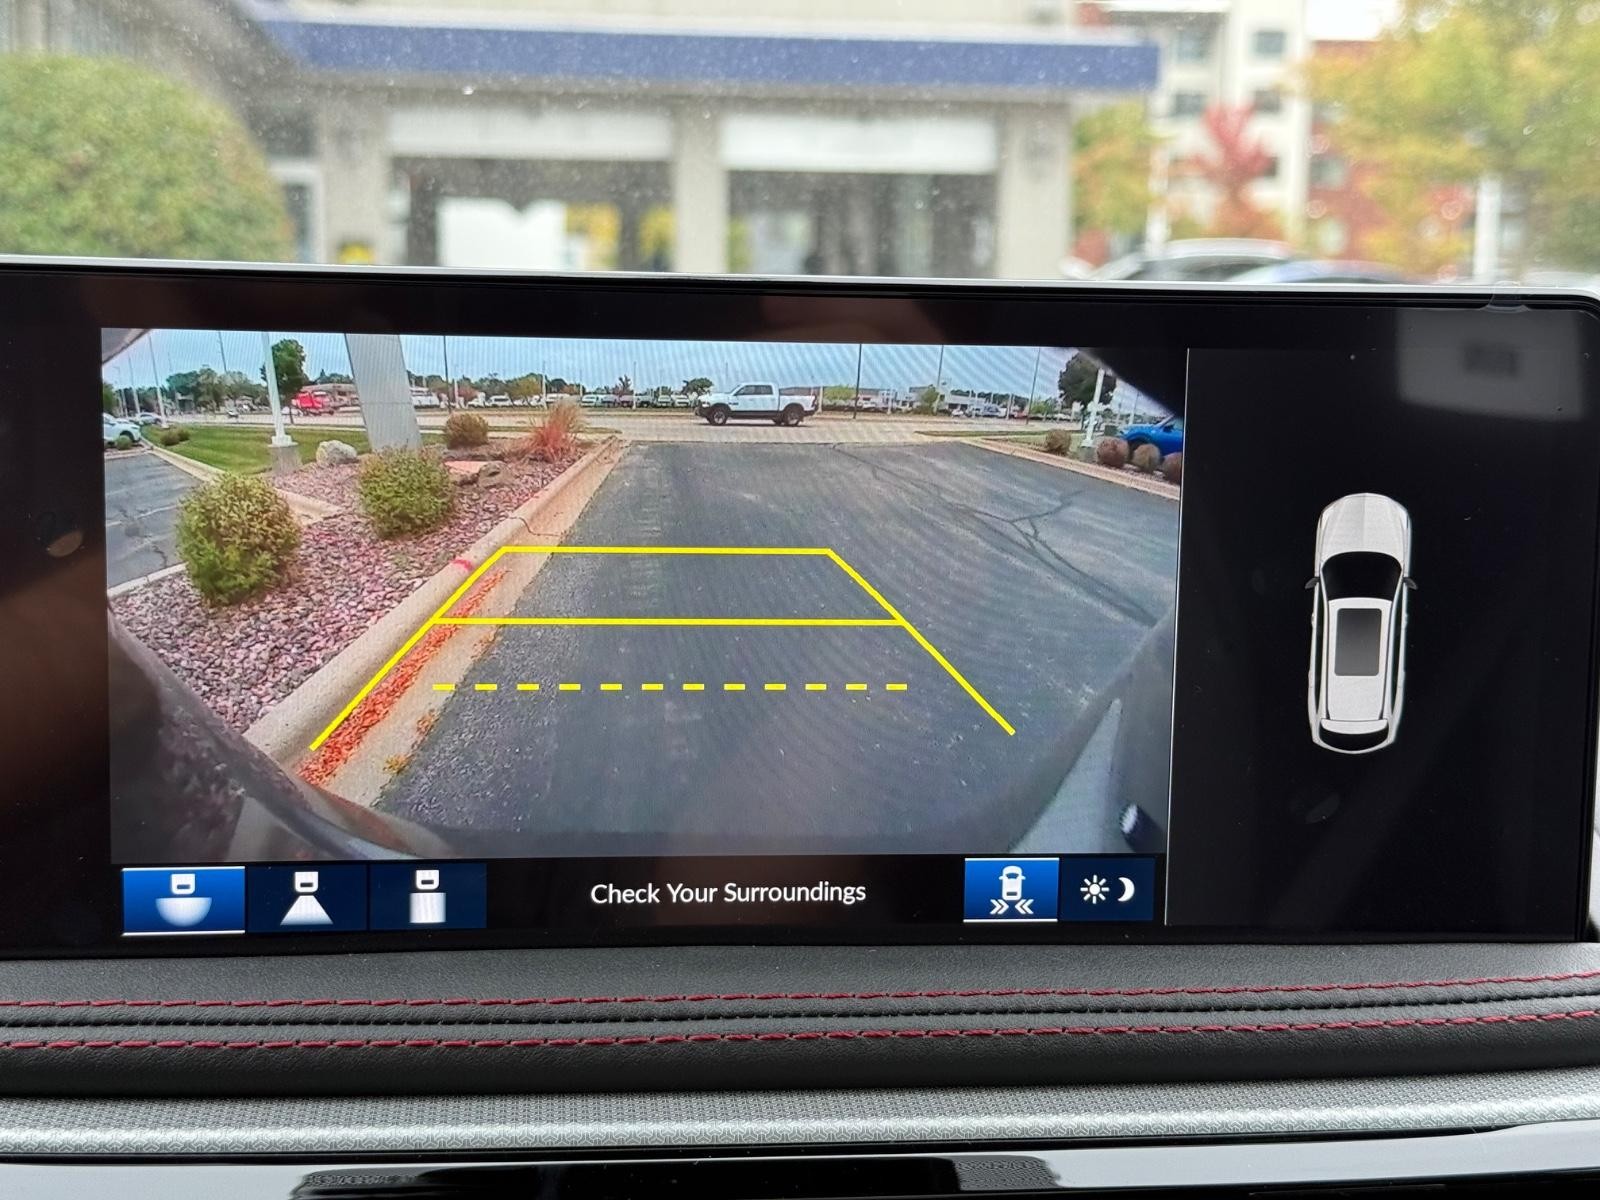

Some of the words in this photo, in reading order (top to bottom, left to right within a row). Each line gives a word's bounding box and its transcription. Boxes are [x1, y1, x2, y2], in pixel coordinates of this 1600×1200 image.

[591, 883, 660, 903] Check
[667, 883, 718, 903] Your
[724, 881, 866, 905] Surroundings
